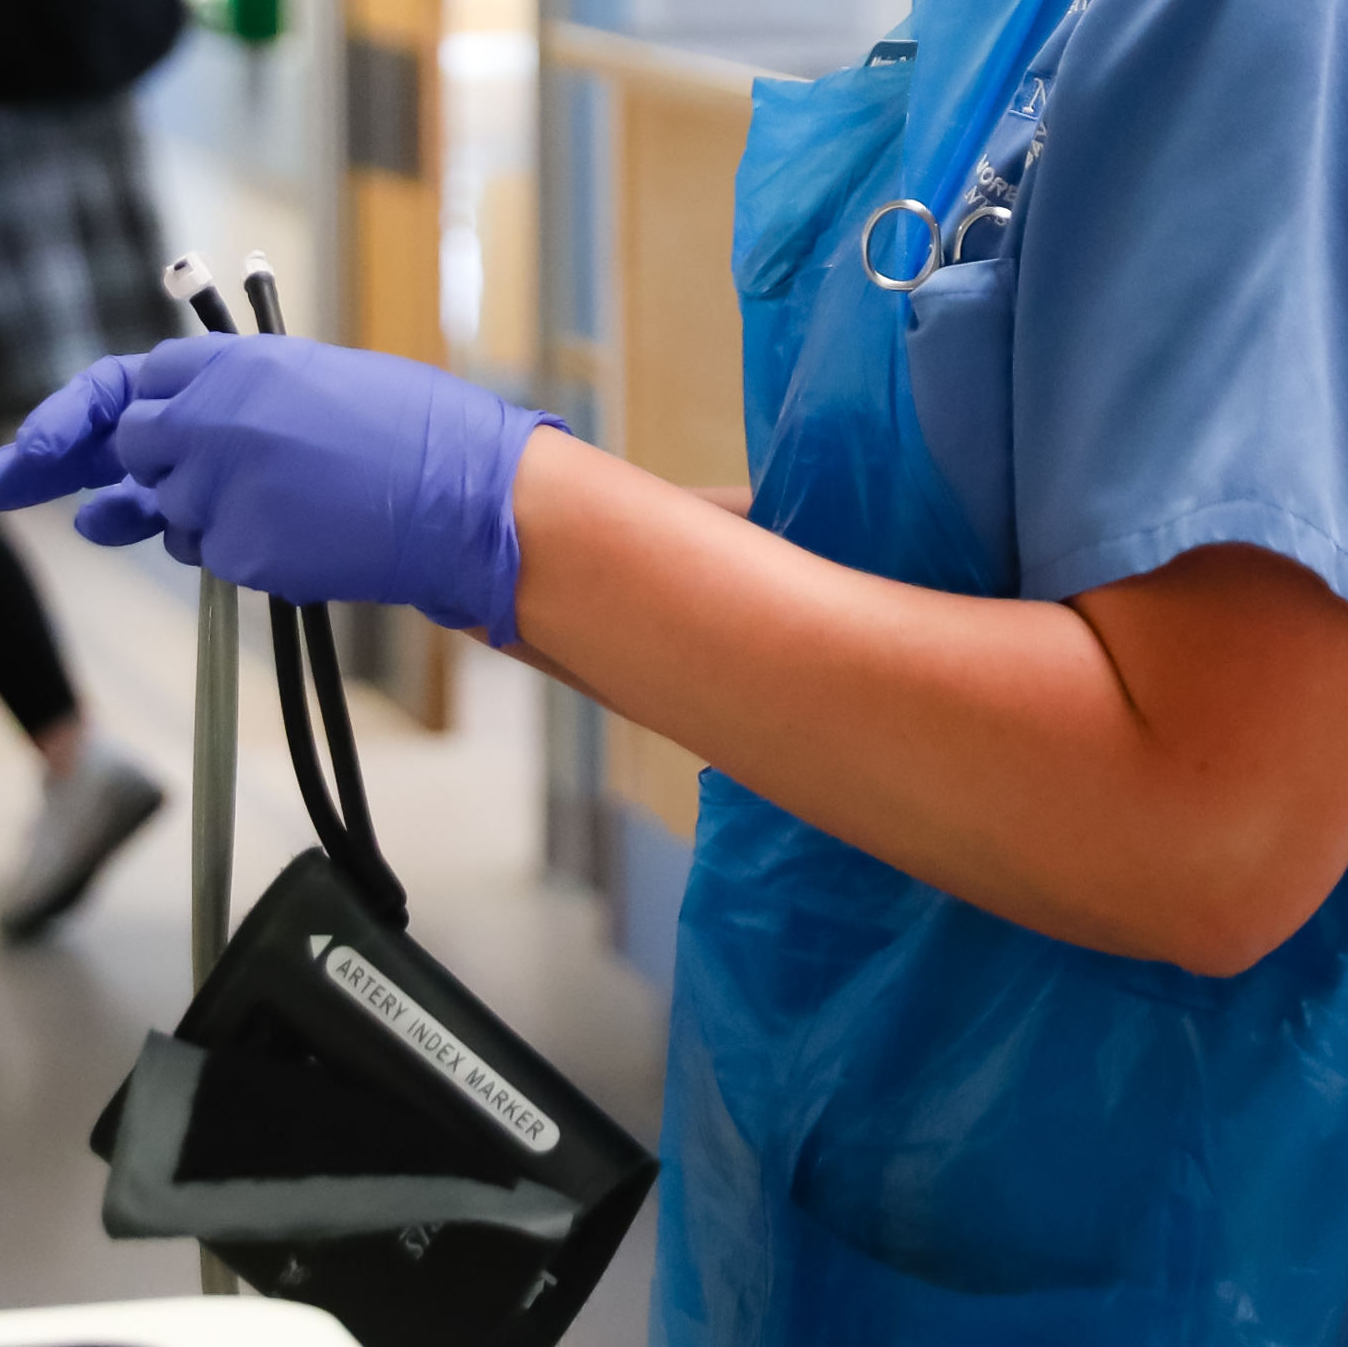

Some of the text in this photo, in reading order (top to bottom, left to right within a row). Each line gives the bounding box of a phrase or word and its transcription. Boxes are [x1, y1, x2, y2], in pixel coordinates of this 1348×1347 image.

[335, 959, 545, 1141] ARTERY INDEX MARKER
